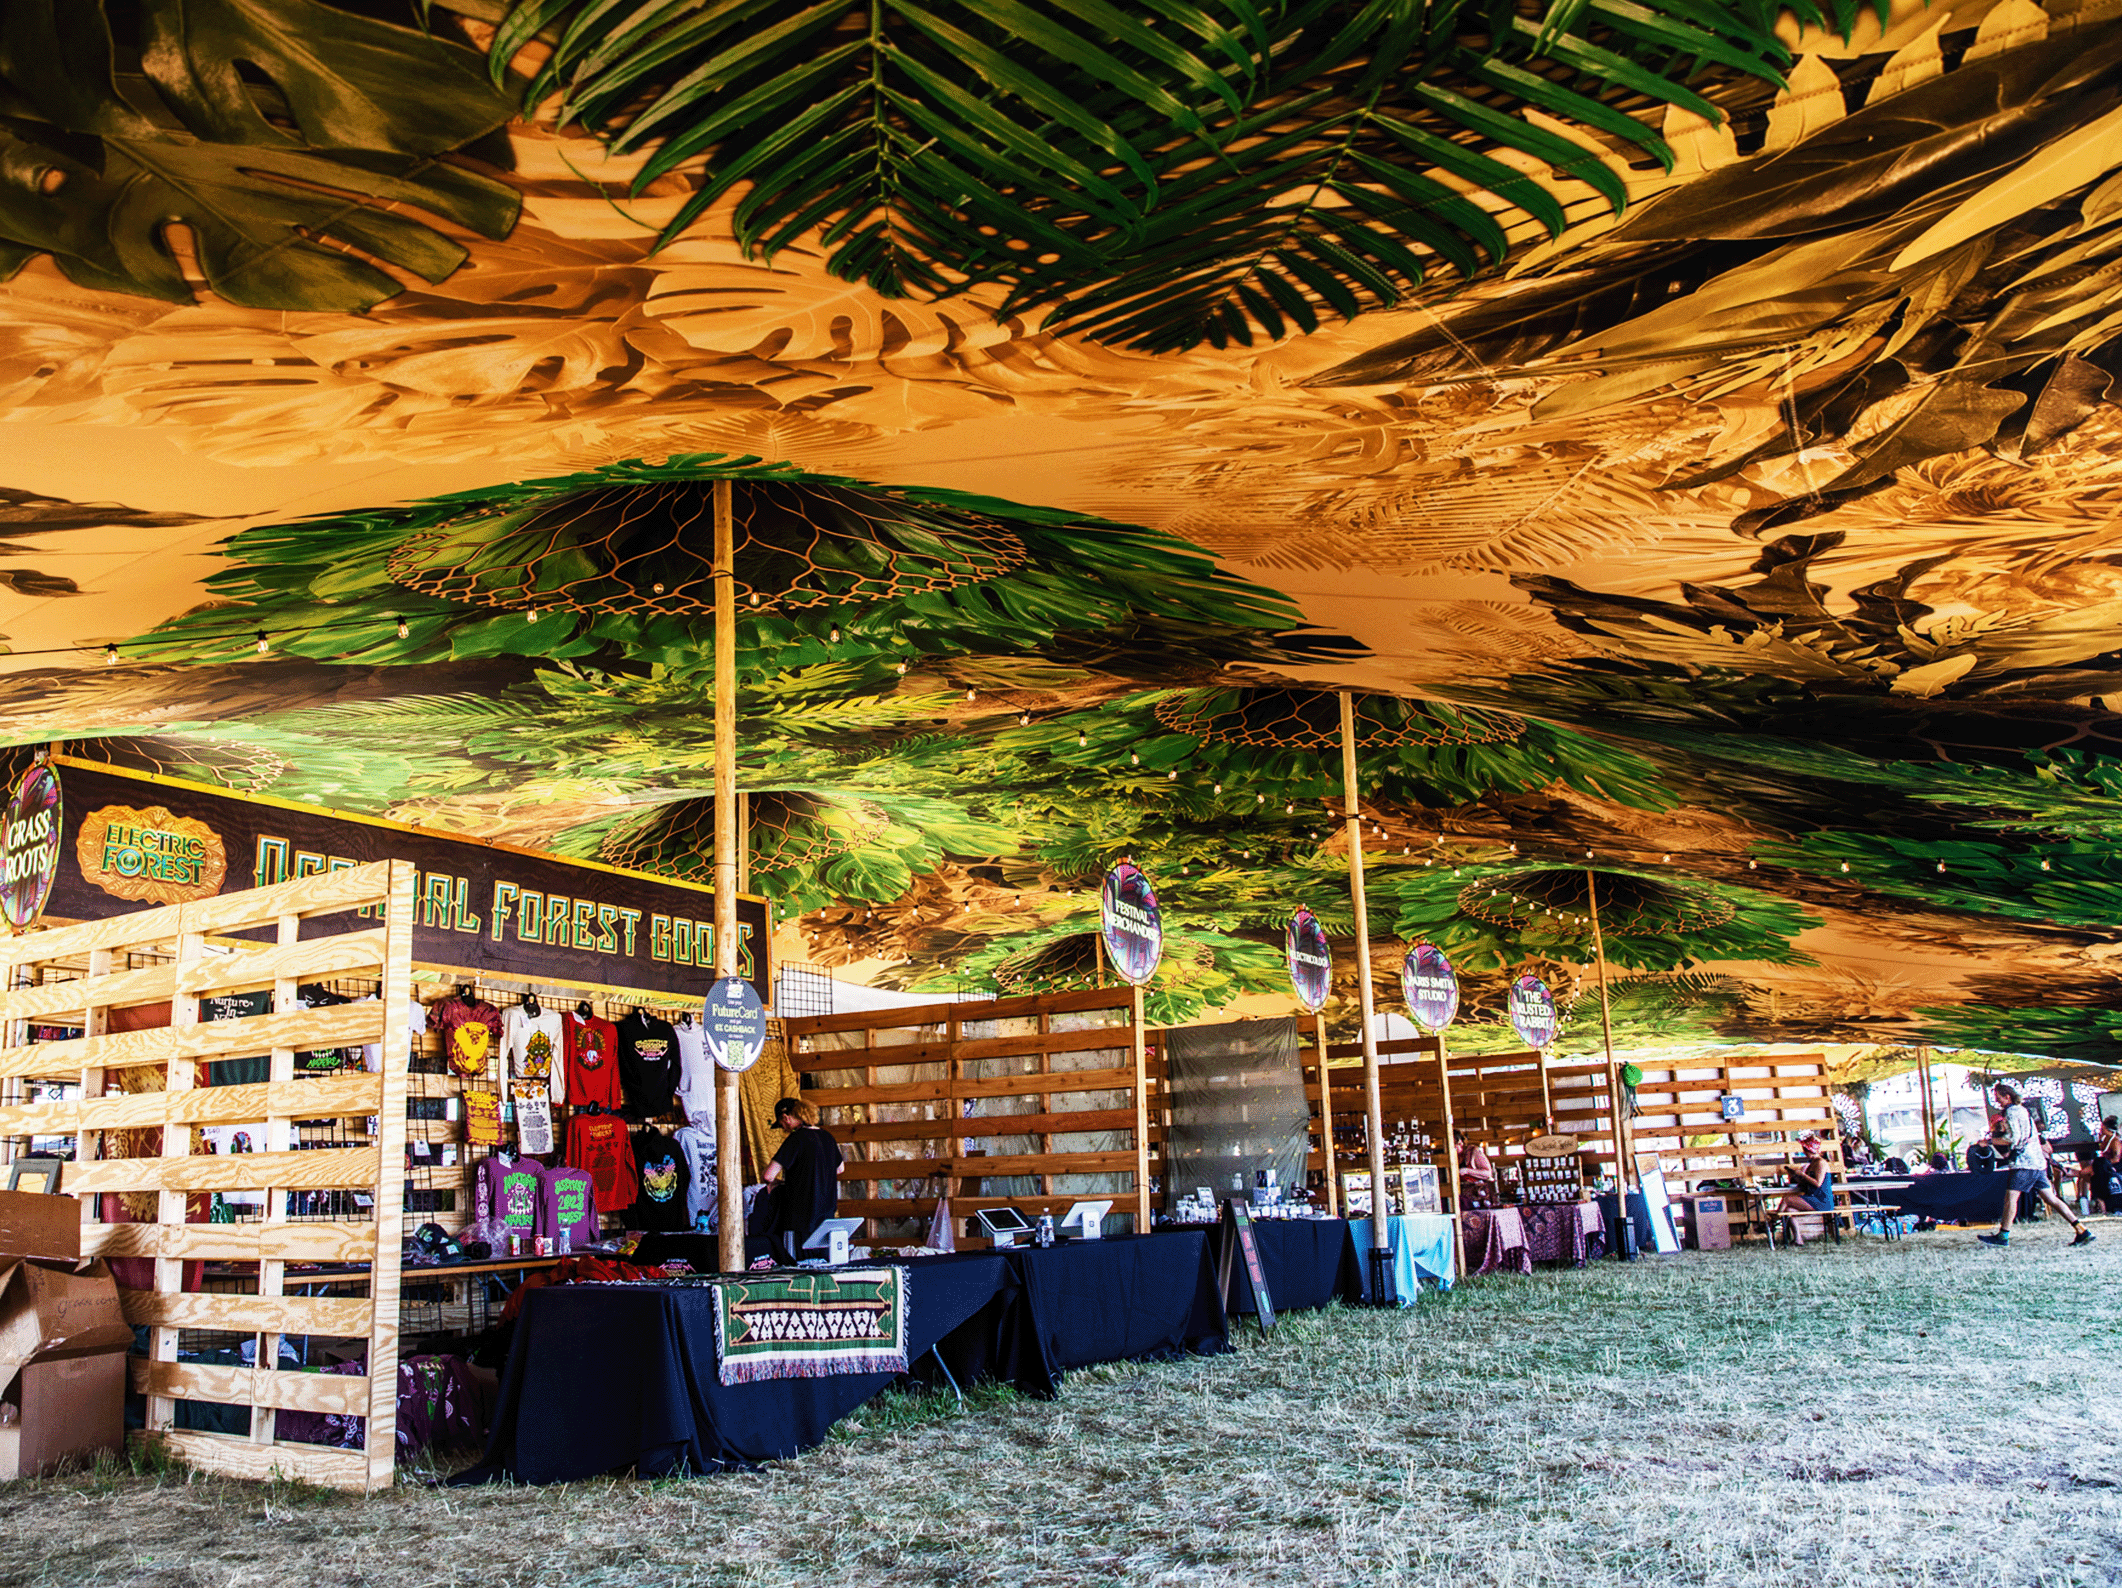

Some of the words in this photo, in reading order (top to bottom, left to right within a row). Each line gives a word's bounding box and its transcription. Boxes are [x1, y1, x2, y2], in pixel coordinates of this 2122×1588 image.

[8, 808, 51, 851] GRASS
[105, 823, 206, 859] ELECTRIC
[5, 842, 50, 884] ROOTS
[101, 844, 206, 887] FOREST
[1114, 899, 1151, 926] FESTIVAL
[492, 879, 642, 957] FOREST
[650, 912, 755, 982] GOOS
[1107, 911, 1160, 942] MERCHANDISE
[1430, 977, 1455, 991] SMITH
[210, 997, 253, 1007] Nurture
[1417, 989, 1447, 1002] STUDIO
[1523, 990, 1543, 1004] THE
[711, 1003, 758, 1020] FutureCard
[1517, 1003, 1551, 1017] RUSTED
[723, 1024, 757, 1034] CASHBACK
[1519, 1015, 1550, 1029] RABBIT
